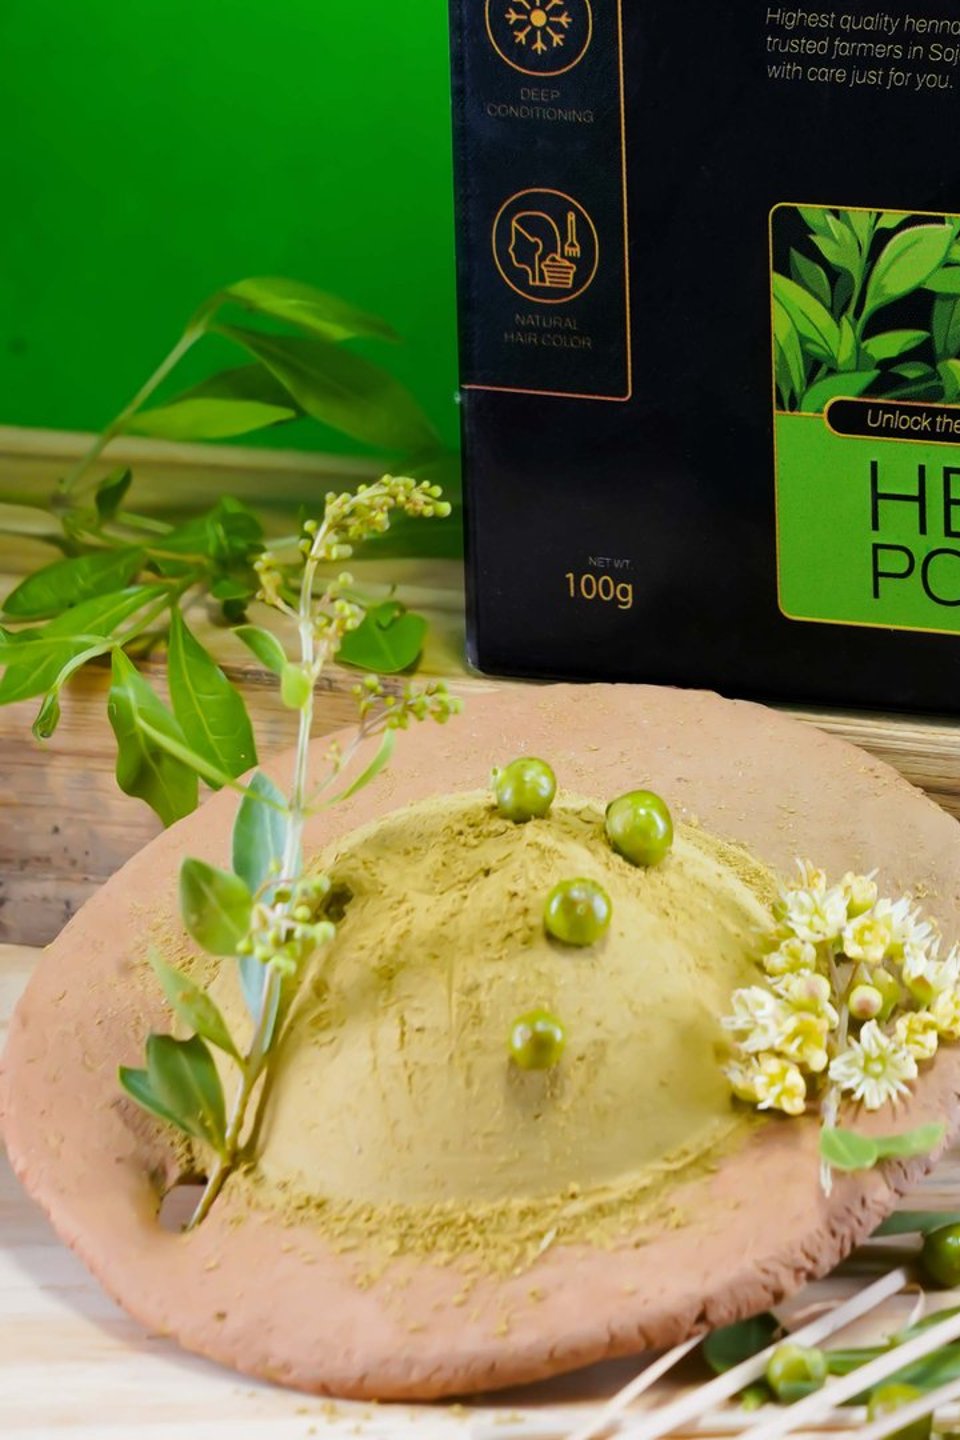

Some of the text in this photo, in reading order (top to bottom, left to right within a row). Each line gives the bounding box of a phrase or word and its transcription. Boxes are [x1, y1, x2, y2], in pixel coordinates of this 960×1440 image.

[766, 8, 835, 31] Highest
[839, 12, 900, 35] quality
[766, 35, 828, 55] trusted
[831, 38, 903, 60] farmers
[907, 42, 923, 59] in
[766, 62, 953, 92] with care just for you.
[520, 88, 560, 102] DEEP
[487, 103, 594, 123] CONDITIONING
[515, 313, 580, 330] NATURAL
[504, 330, 592, 349] HAIR COLOR
[867, 409, 931, 431] Unlock
[588, 556, 611, 568] NET
[565, 572, 633, 609] 100g
